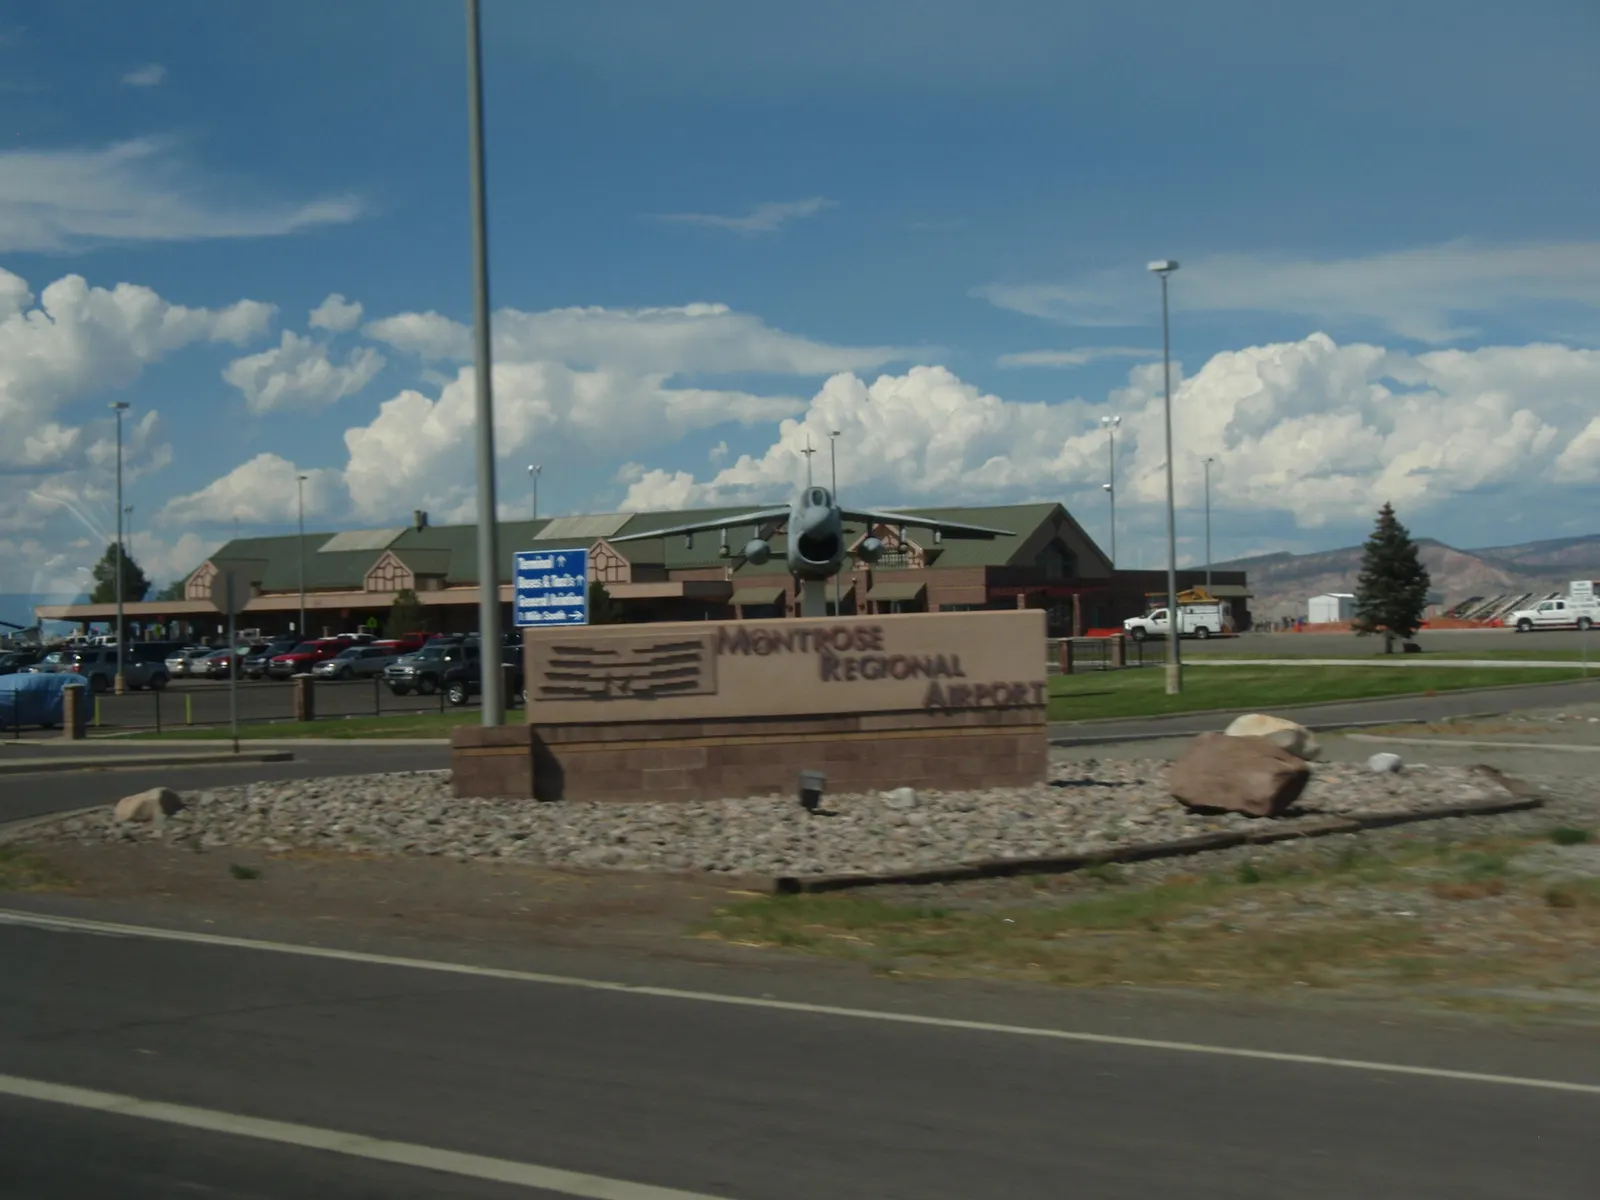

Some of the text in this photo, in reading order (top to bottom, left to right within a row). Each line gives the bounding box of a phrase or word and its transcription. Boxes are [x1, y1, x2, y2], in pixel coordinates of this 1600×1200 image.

[717, 626, 884, 656] MONTROSE
[820, 655, 966, 682] REGIONAL
[924, 680, 1046, 709] AIRPORT
